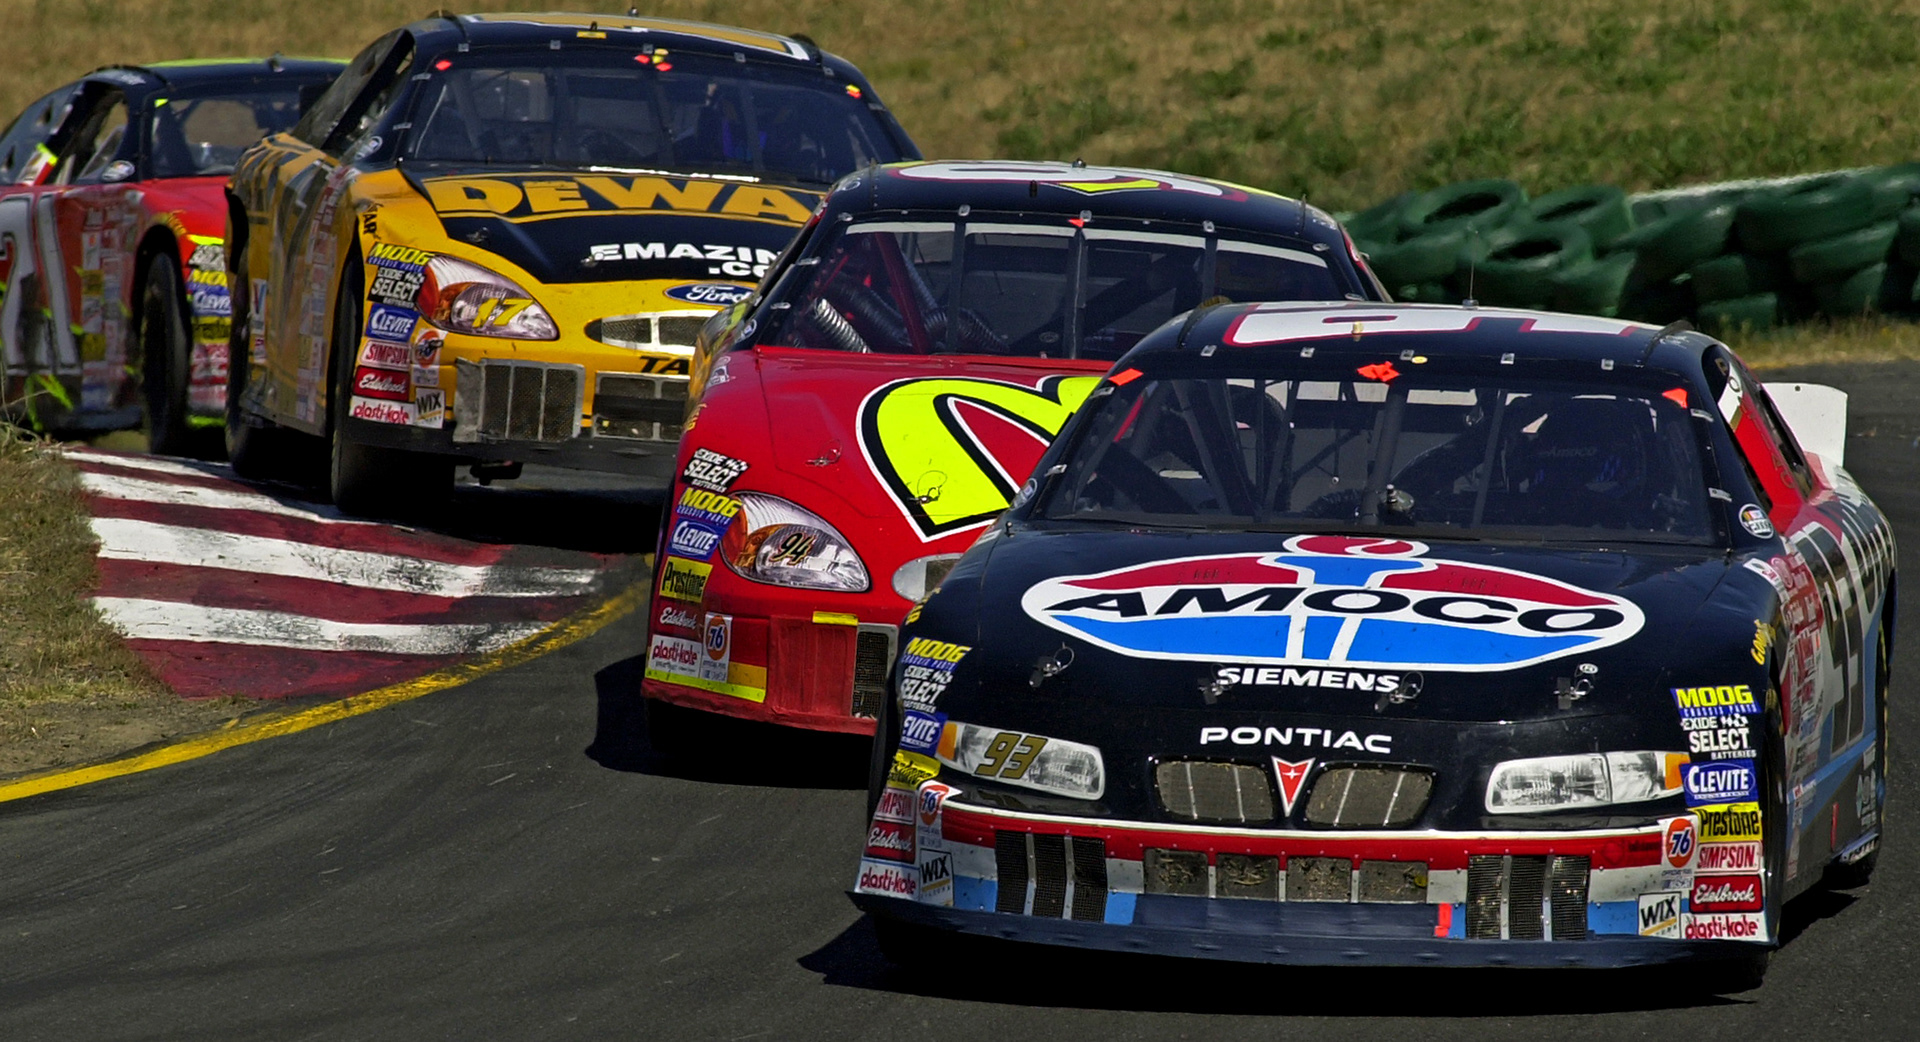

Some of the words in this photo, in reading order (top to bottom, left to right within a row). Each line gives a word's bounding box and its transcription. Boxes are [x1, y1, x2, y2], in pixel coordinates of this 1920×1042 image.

[370, 243, 434, 265] MOOG
[371, 278, 420, 301] SELECT
[686, 284, 755, 304] Ford
[472, 298, 534, 328] 17
[366, 343, 410, 365] SIMPSON
[416, 393, 441, 413] WIX
[684, 460, 739, 485] SELECT
[678, 487, 743, 518] MOOG
[771, 532, 816, 565] 94
[1042, 586, 1625, 633] AMOCO
[708, 625, 725, 650] 76
[904, 637, 972, 663] MOOG
[1217, 667, 1400, 692] SIEMENS
[1676, 684, 1753, 708] MOOG
[1681, 716, 1718, 731] EXIDE
[1200, 727, 1392, 754] PONTIAC
[1689, 728, 1750, 753] SELECT
[974, 732, 1048, 779] 93
[1711, 749, 1757, 760] BATTERIES
[921, 790, 941, 815] 76
[1699, 805, 1760, 837] Prestone
[1669, 829, 1692, 858] 76
[1697, 845, 1756, 868] SIMPSON
[860, 867, 917, 894] plasti-kote
[921, 856, 949, 883] WIX
[1694, 883, 1755, 905] Edelbrock
[1641, 896, 1676, 928] WIX
